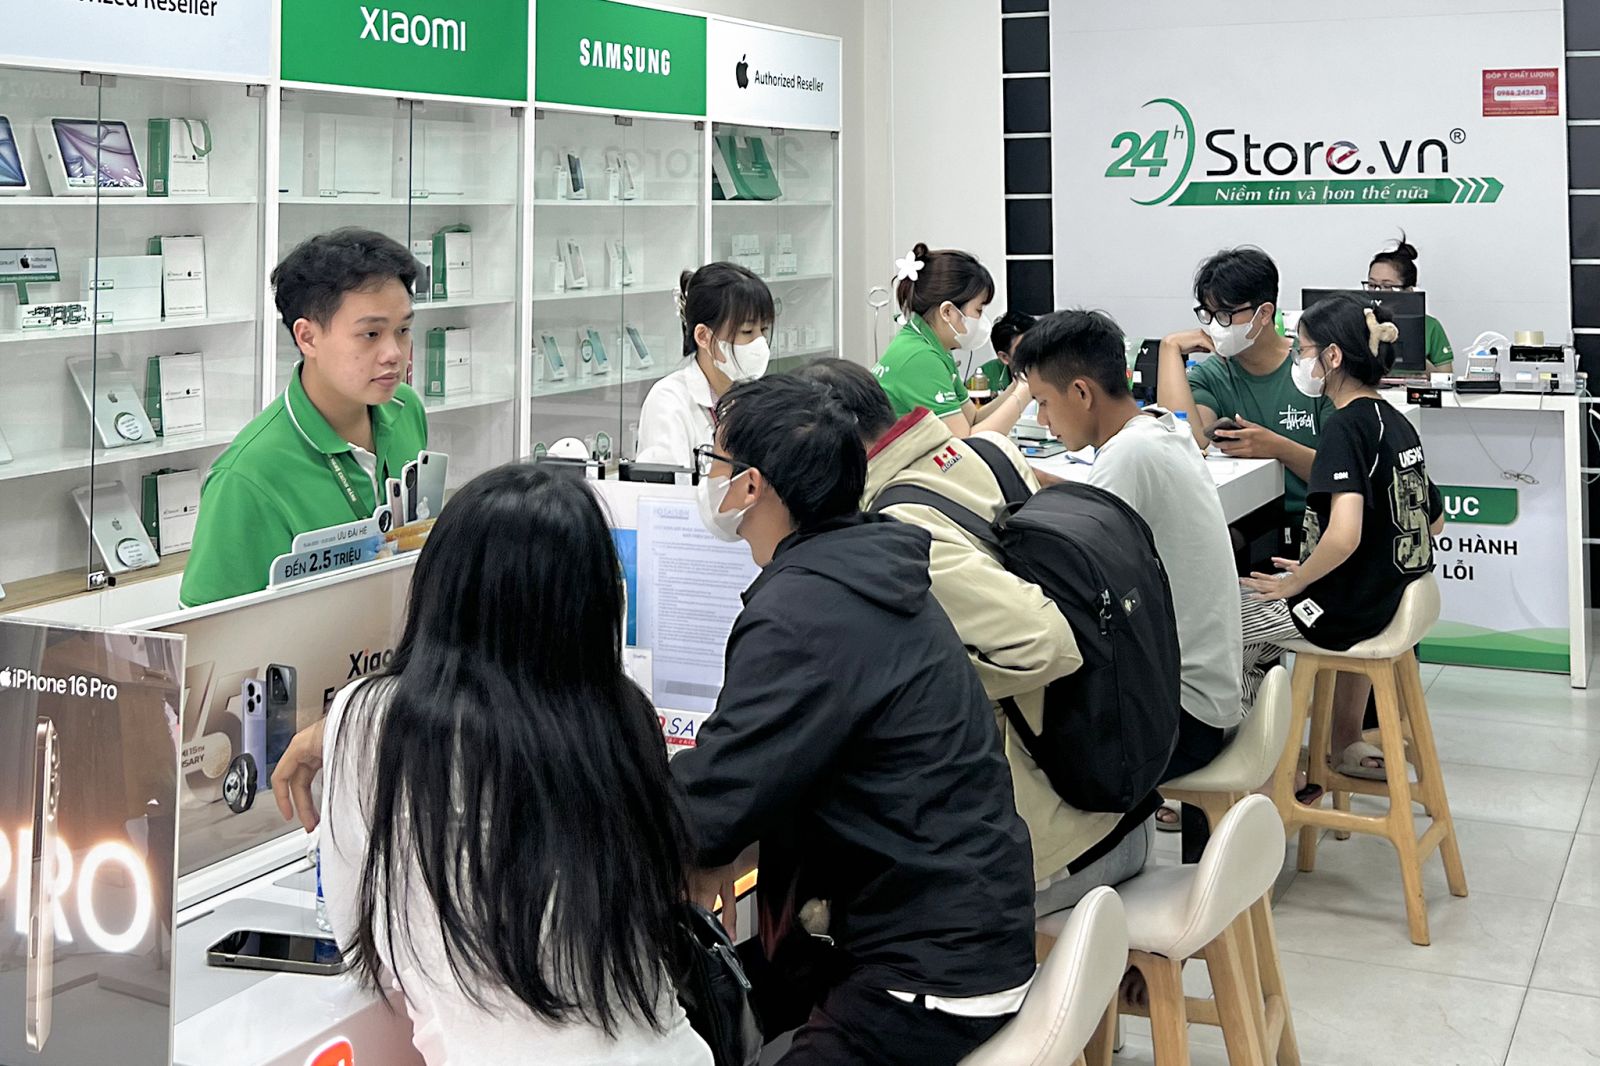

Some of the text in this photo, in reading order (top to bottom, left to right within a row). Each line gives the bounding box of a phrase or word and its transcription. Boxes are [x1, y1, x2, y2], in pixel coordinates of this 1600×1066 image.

[579, 38, 671, 76] SAMSUNG
[754, 70, 824, 92] Authorized Reseller
[1215, 182, 1428, 201] Niềm tin và hơn thế nữa
[1459, 533, 1518, 556] HÀNH
[285, 548, 362, 578] ĐẾN 2.5 TRIỆU
[1443, 559, 1474, 581] LỖI
[12, 669, 118, 700] iPhone 16 Pro
